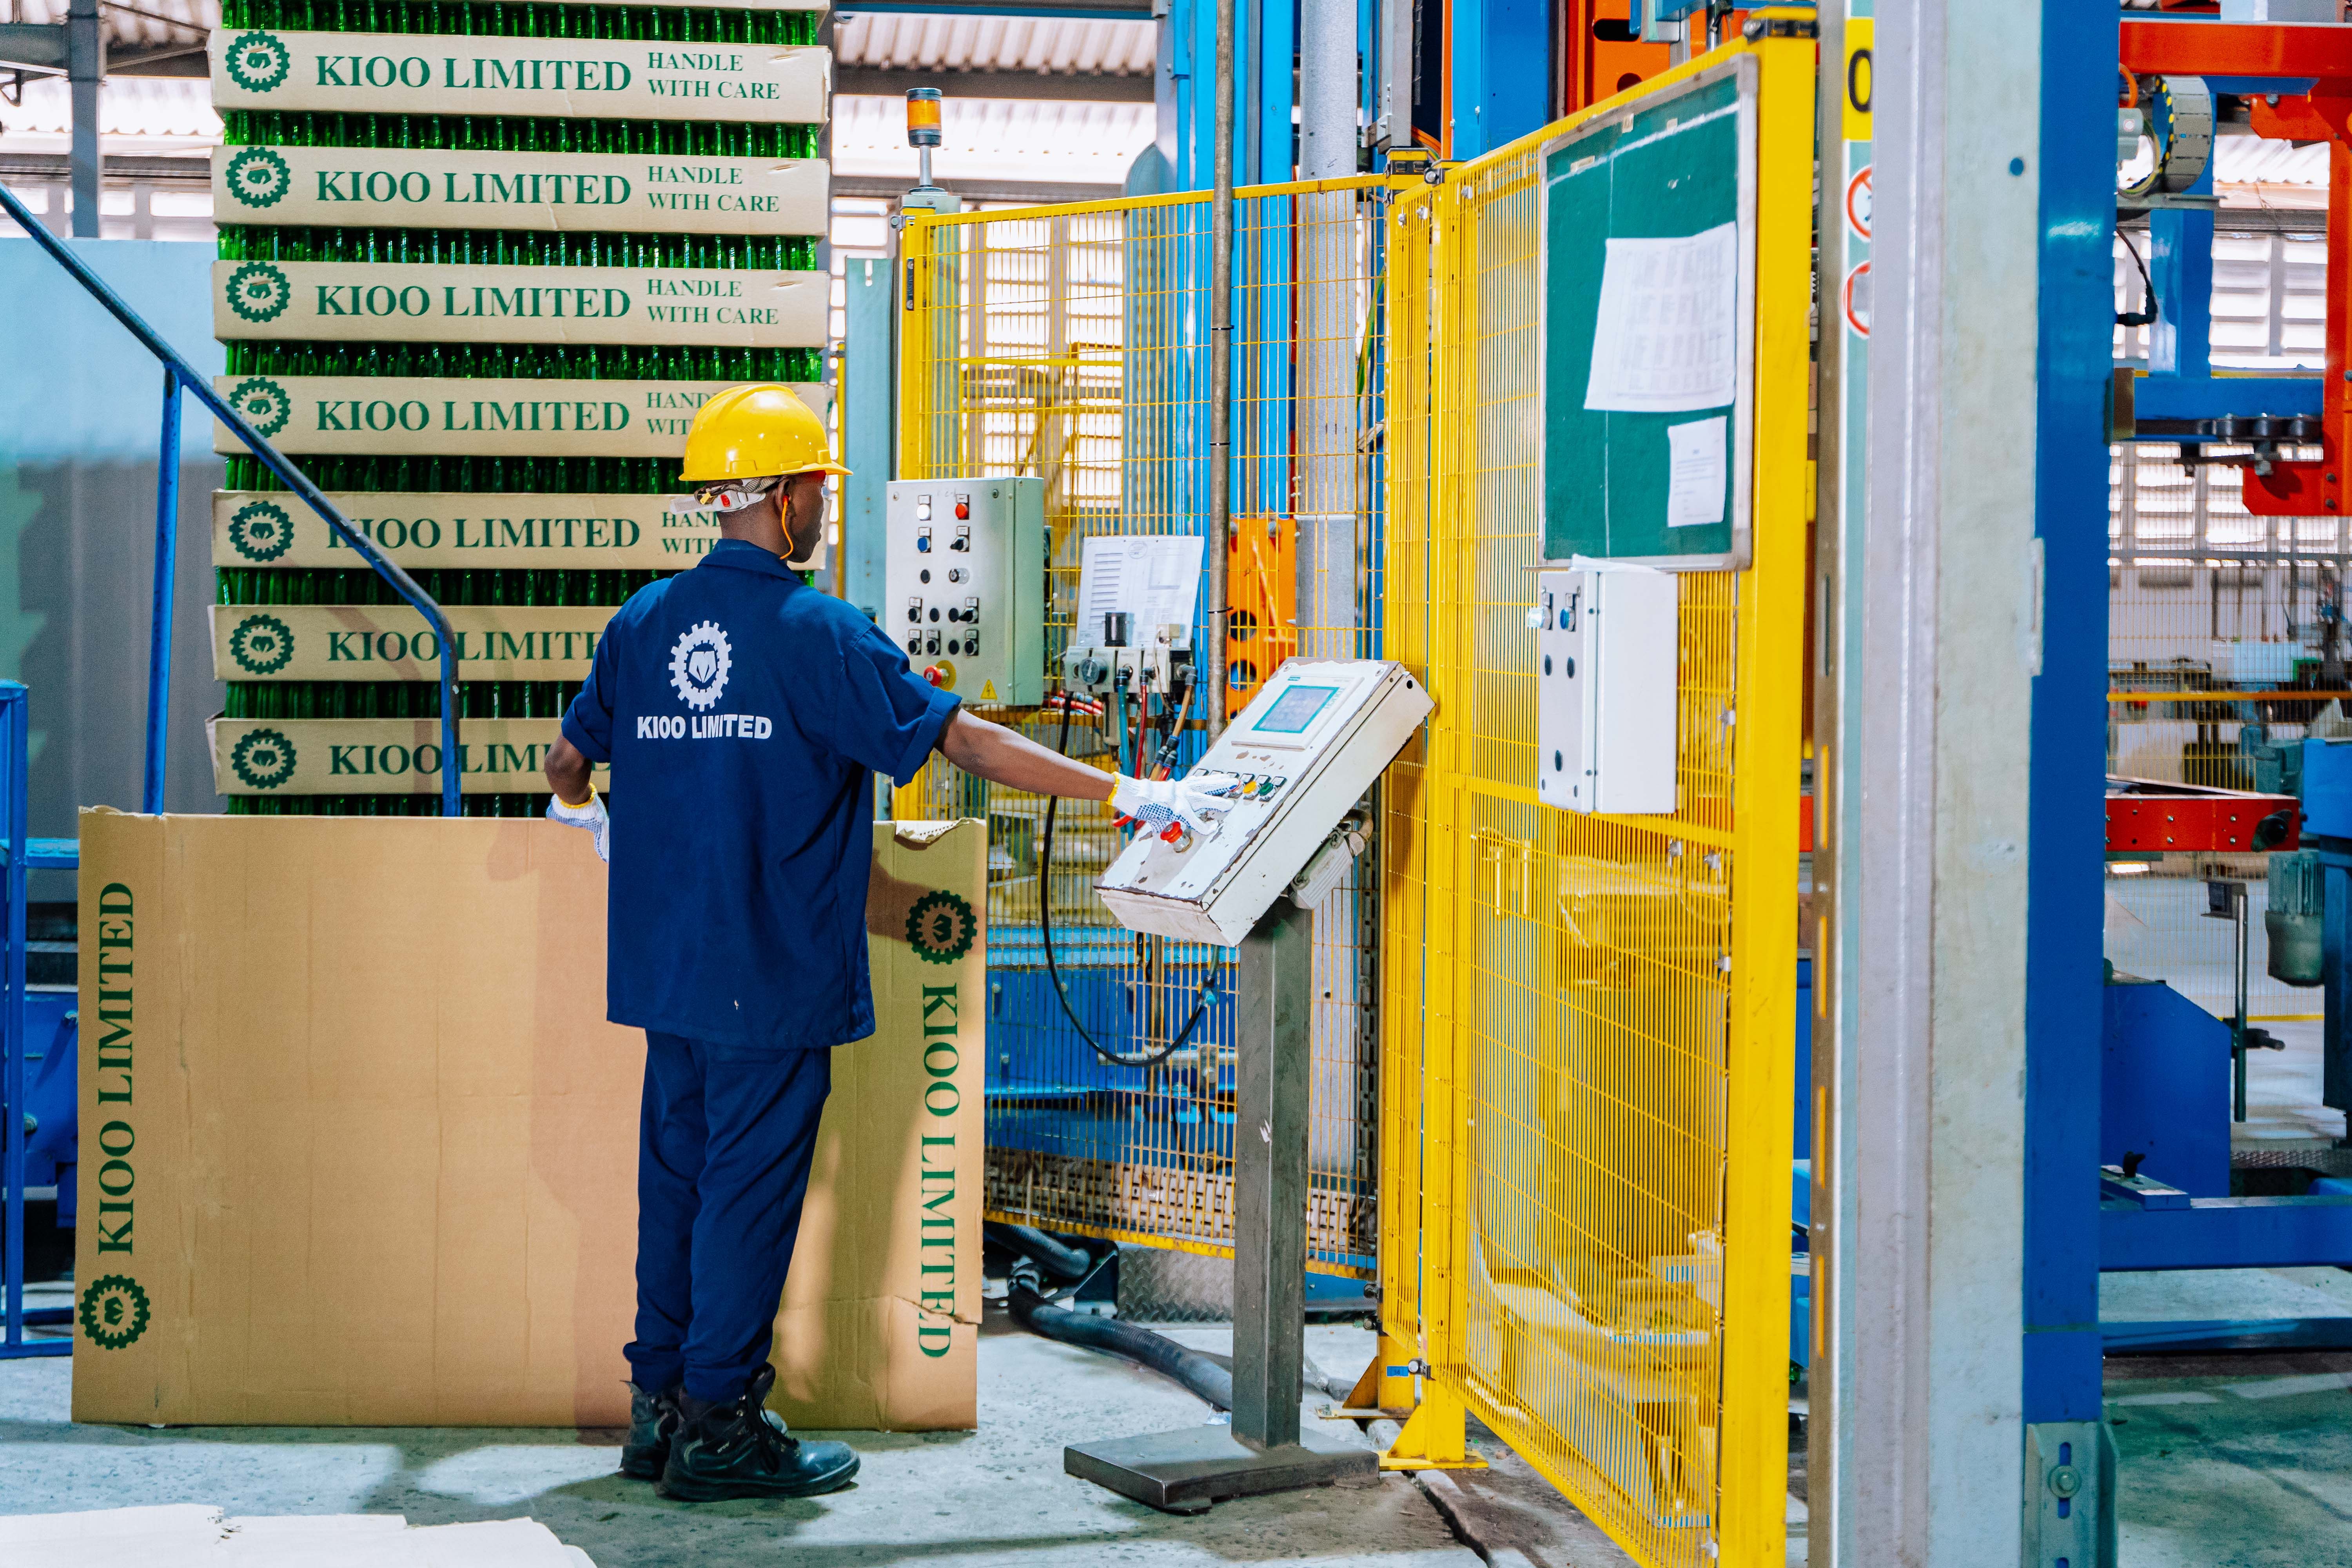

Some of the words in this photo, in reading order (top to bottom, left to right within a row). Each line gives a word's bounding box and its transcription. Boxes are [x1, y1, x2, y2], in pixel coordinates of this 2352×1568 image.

[315, 55, 431, 88] KIOO
[443, 58, 632, 91] LIMITED
[647, 52, 743, 71] HANDLE
[647, 79, 710, 97] WITH
[717, 81, 780, 100] CARE
[315, 171, 431, 202] KIOO
[443, 172, 632, 205] LIMITED
[647, 165, 743, 185] HANDLE
[647, 192, 710, 212] WITH
[717, 194, 780, 213] CARE
[315, 285, 431, 316] KIOO
[443, 286, 631, 318] LIMITED
[646, 278, 742, 298] HANDLE
[647, 305, 710, 324] WITH
[717, 306, 779, 326] CARE
[646, 392, 717, 408] HAND
[315, 401, 430, 431] KIOO
[443, 401, 630, 432] LIMITED
[646, 419, 694, 435] WIT
[454, 518, 641, 548] LIMITED
[327, 632, 441, 662] KIOO
[454, 632, 604, 661] LIMITE
[637, 715, 686, 739] KIOO
[691, 714, 772, 739] LIMITED
[330, 744, 443, 775] KIOO
[98, 882, 134, 1105] LIMITED
[922, 982, 960, 1117] KIOO
[98, 1120, 136, 1256] KIOO
[918, 1134, 956, 1359] LIMITED
